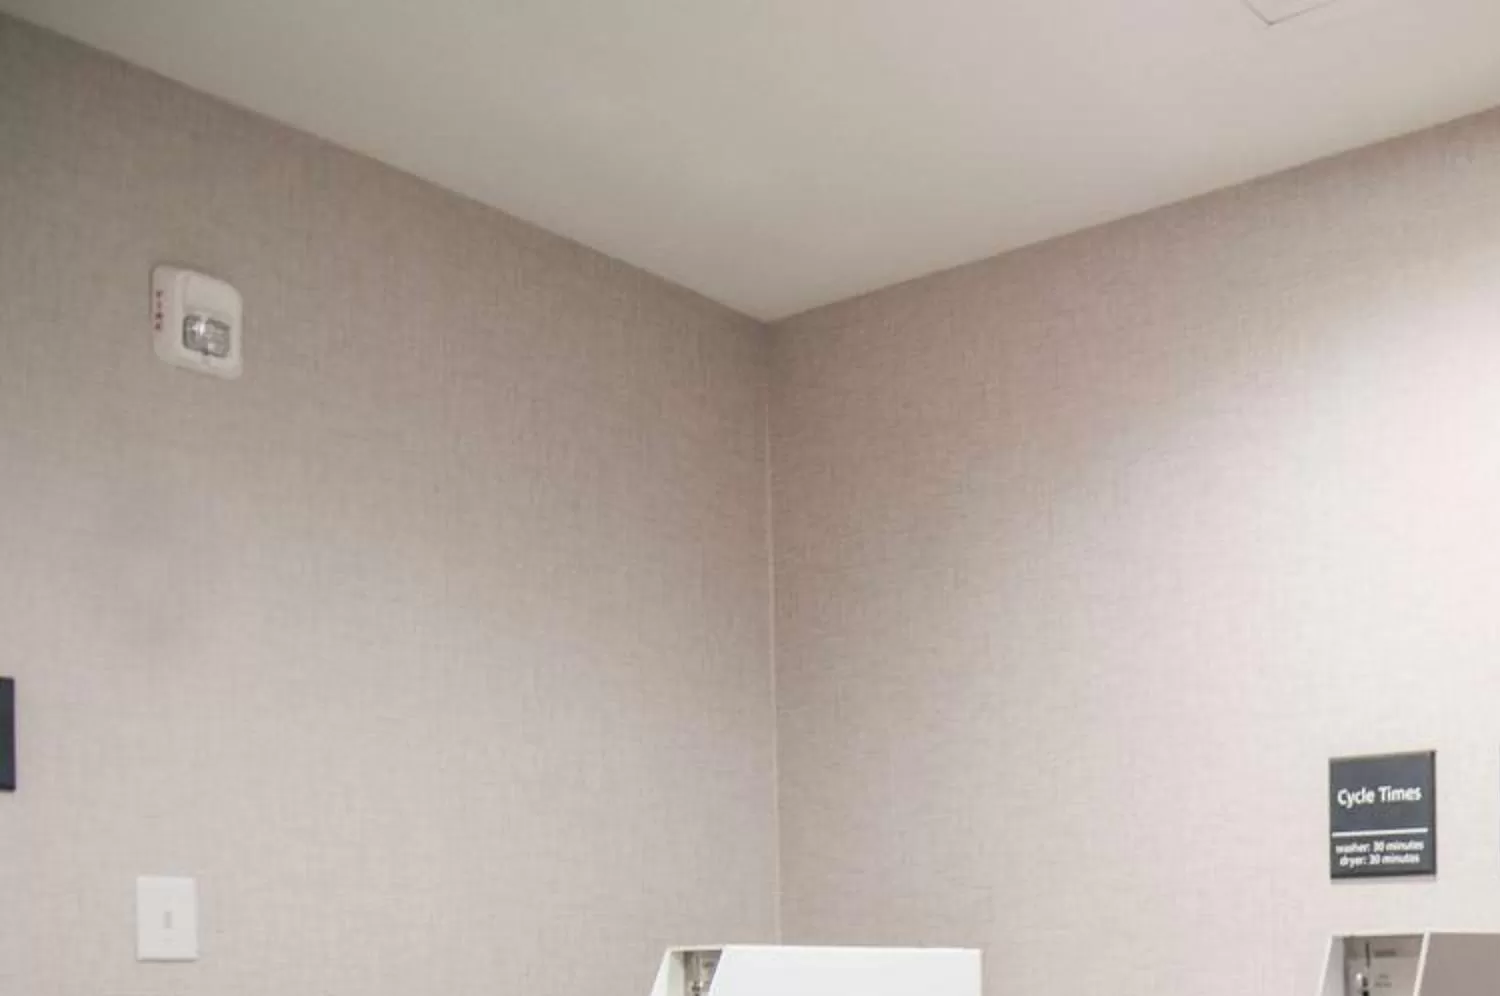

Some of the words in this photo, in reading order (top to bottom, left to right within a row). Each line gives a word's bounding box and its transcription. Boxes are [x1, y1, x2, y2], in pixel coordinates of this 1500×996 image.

[1337, 787, 1375, 809] Cycle
[1377, 785, 1422, 803] Times
[1386, 840, 1424, 852] minutes
[1381, 853, 1421, 865] minutes
